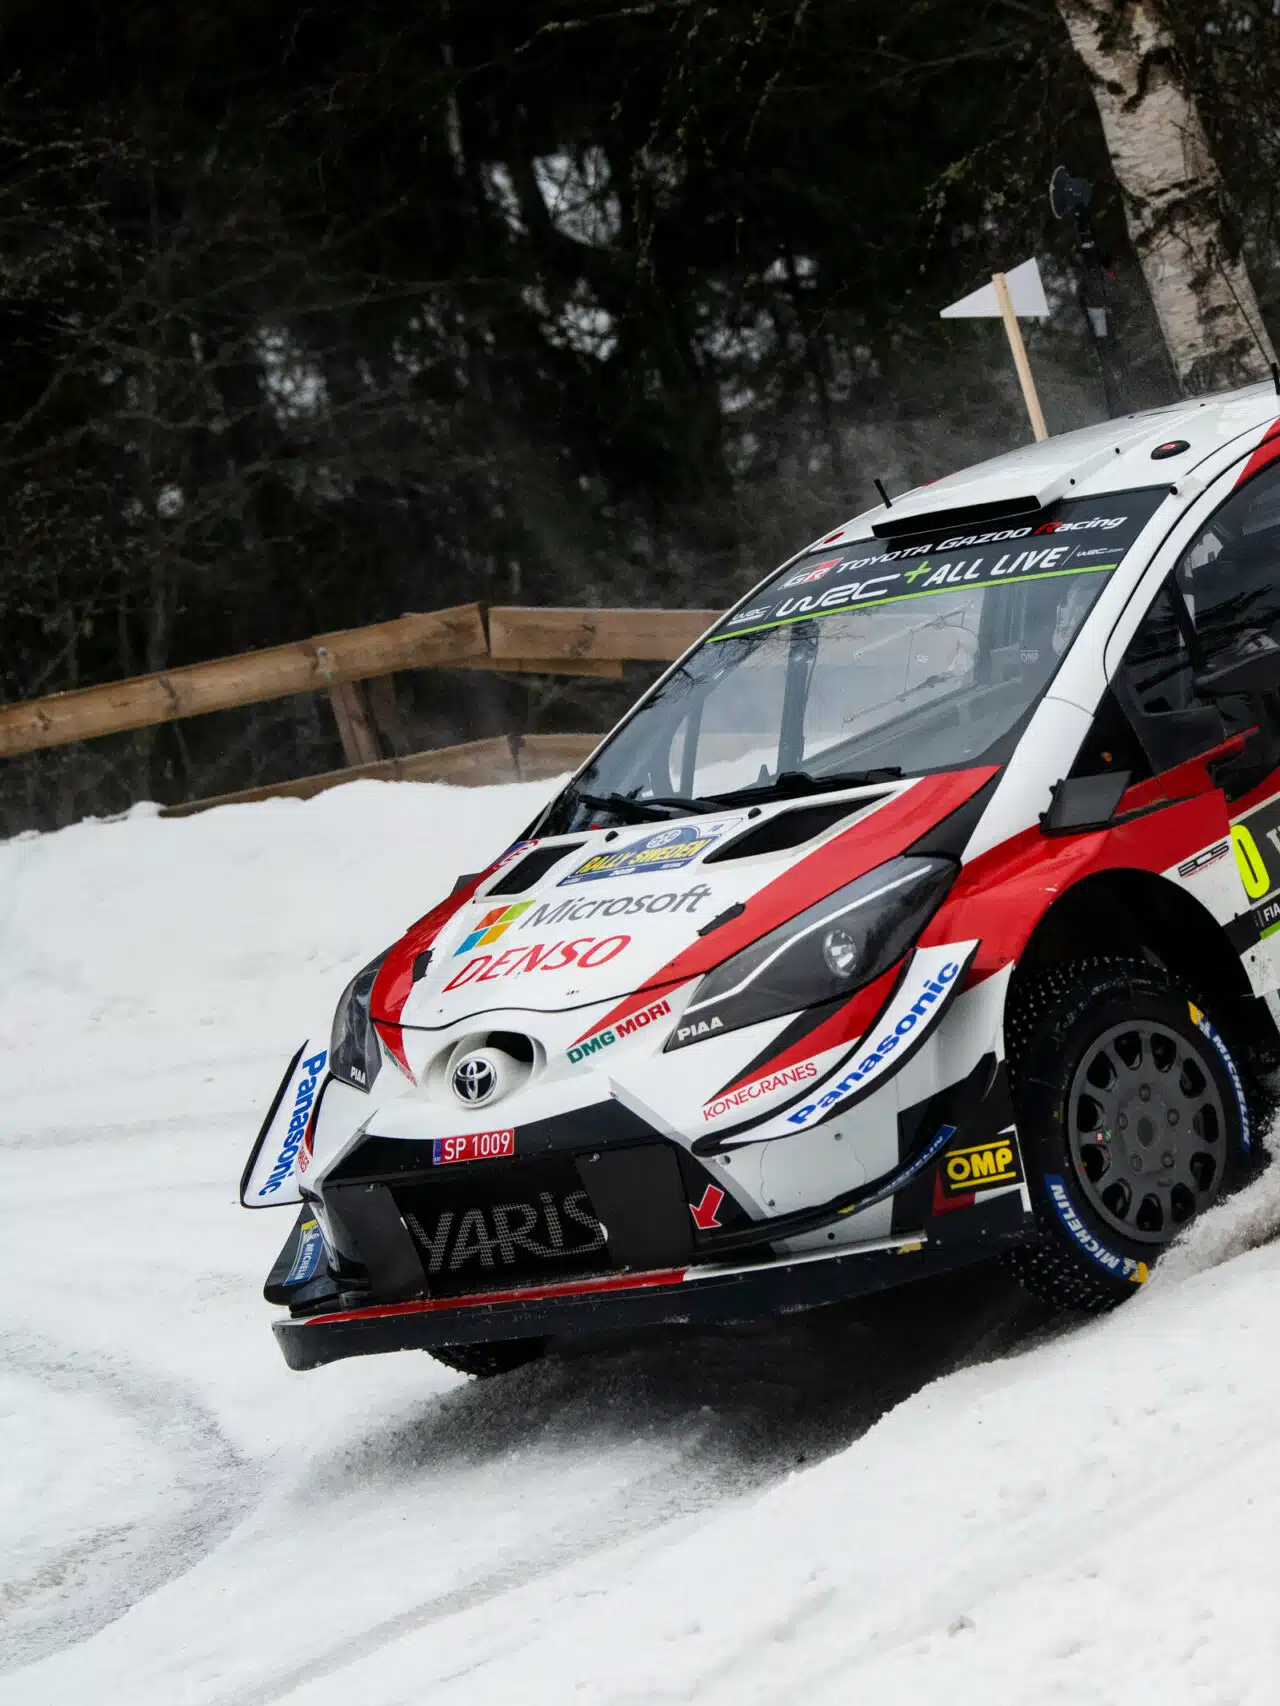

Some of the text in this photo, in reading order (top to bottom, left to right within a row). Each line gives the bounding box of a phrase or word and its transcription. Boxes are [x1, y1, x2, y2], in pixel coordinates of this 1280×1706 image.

[836, 544, 933, 573] TOYOTA
[936, 527, 1032, 551] GAZOO
[1034, 516, 1128, 535] Racing
[921, 558, 984, 587] ALL
[991, 546, 1070, 576] LIVE
[575, 851, 633, 875] RALLY
[629, 838, 713, 865] SWEDEN
[518, 883, 713, 930] Microsoft
[442, 935, 632, 993] DENSO
[566, 1000, 671, 1065] DMG MORI
[677, 1016, 724, 1042] PIAA
[787, 961, 960, 1125] Panasonic
[350, 1065, 366, 1085] PIAA
[702, 1061, 818, 1122] KONECRANES
[1211, 1033, 1250, 1146] MICHELIN
[258, 1049, 329, 1197] Panasonic
[444, 1132, 510, 1161] SP 1009
[946, 1146, 1014, 1182] OMP
[1049, 1183, 1118, 1270] MICHELIN
